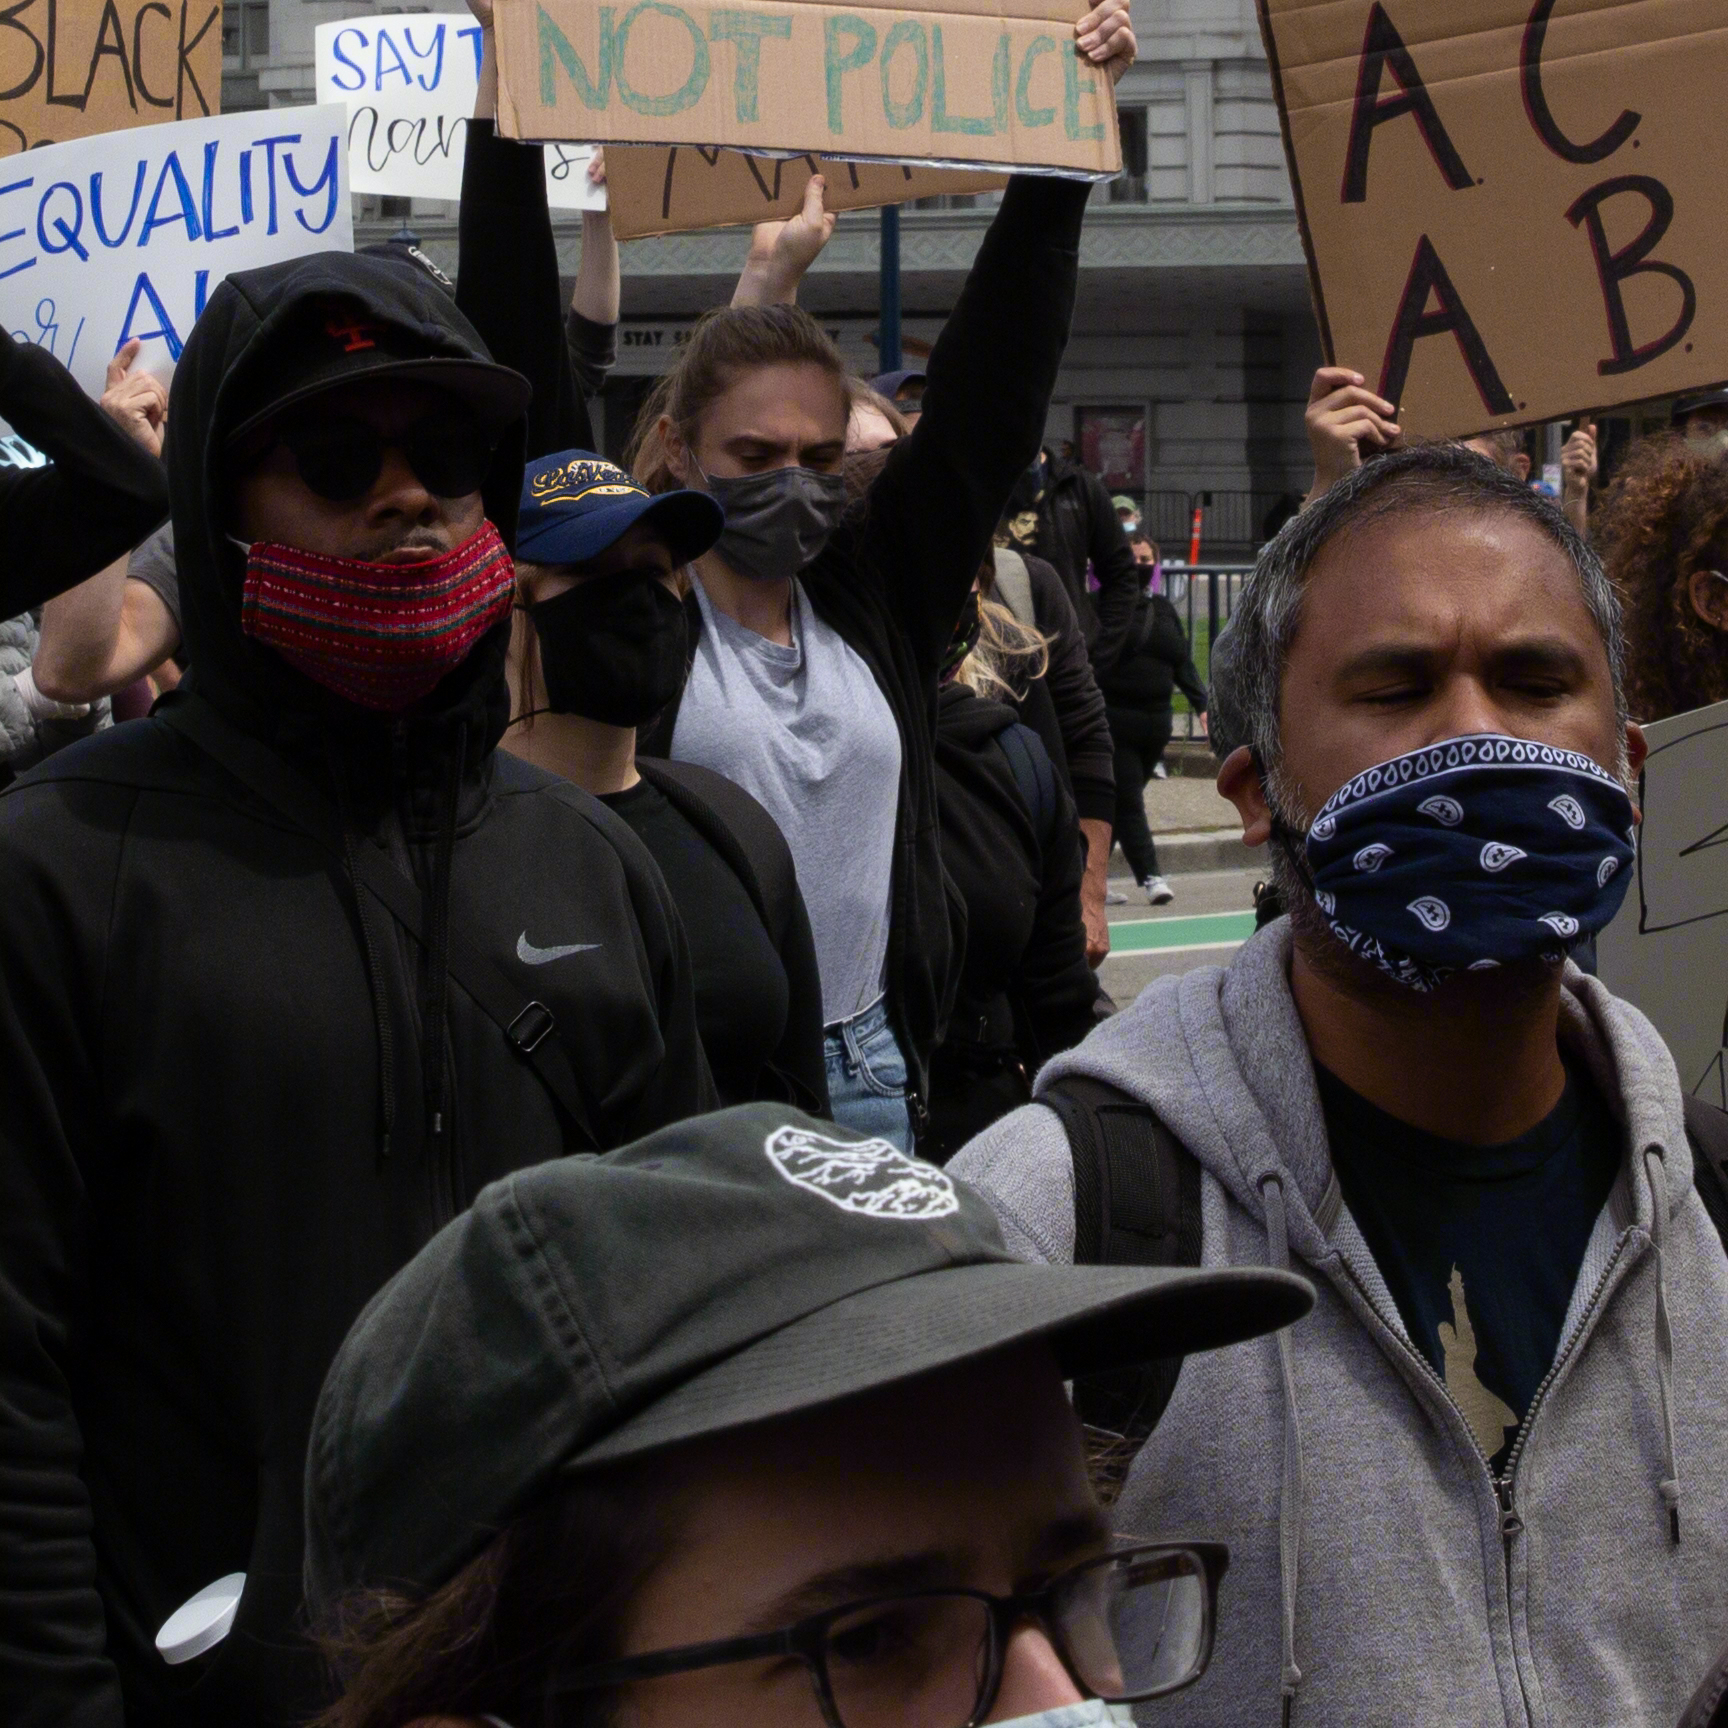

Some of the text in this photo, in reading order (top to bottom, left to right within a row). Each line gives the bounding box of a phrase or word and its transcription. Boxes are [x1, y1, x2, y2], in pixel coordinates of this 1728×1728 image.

[330, 22, 447, 92] SAY
[821, 13, 1107, 141] POLICE
[624, 329, 665, 347] STAY
